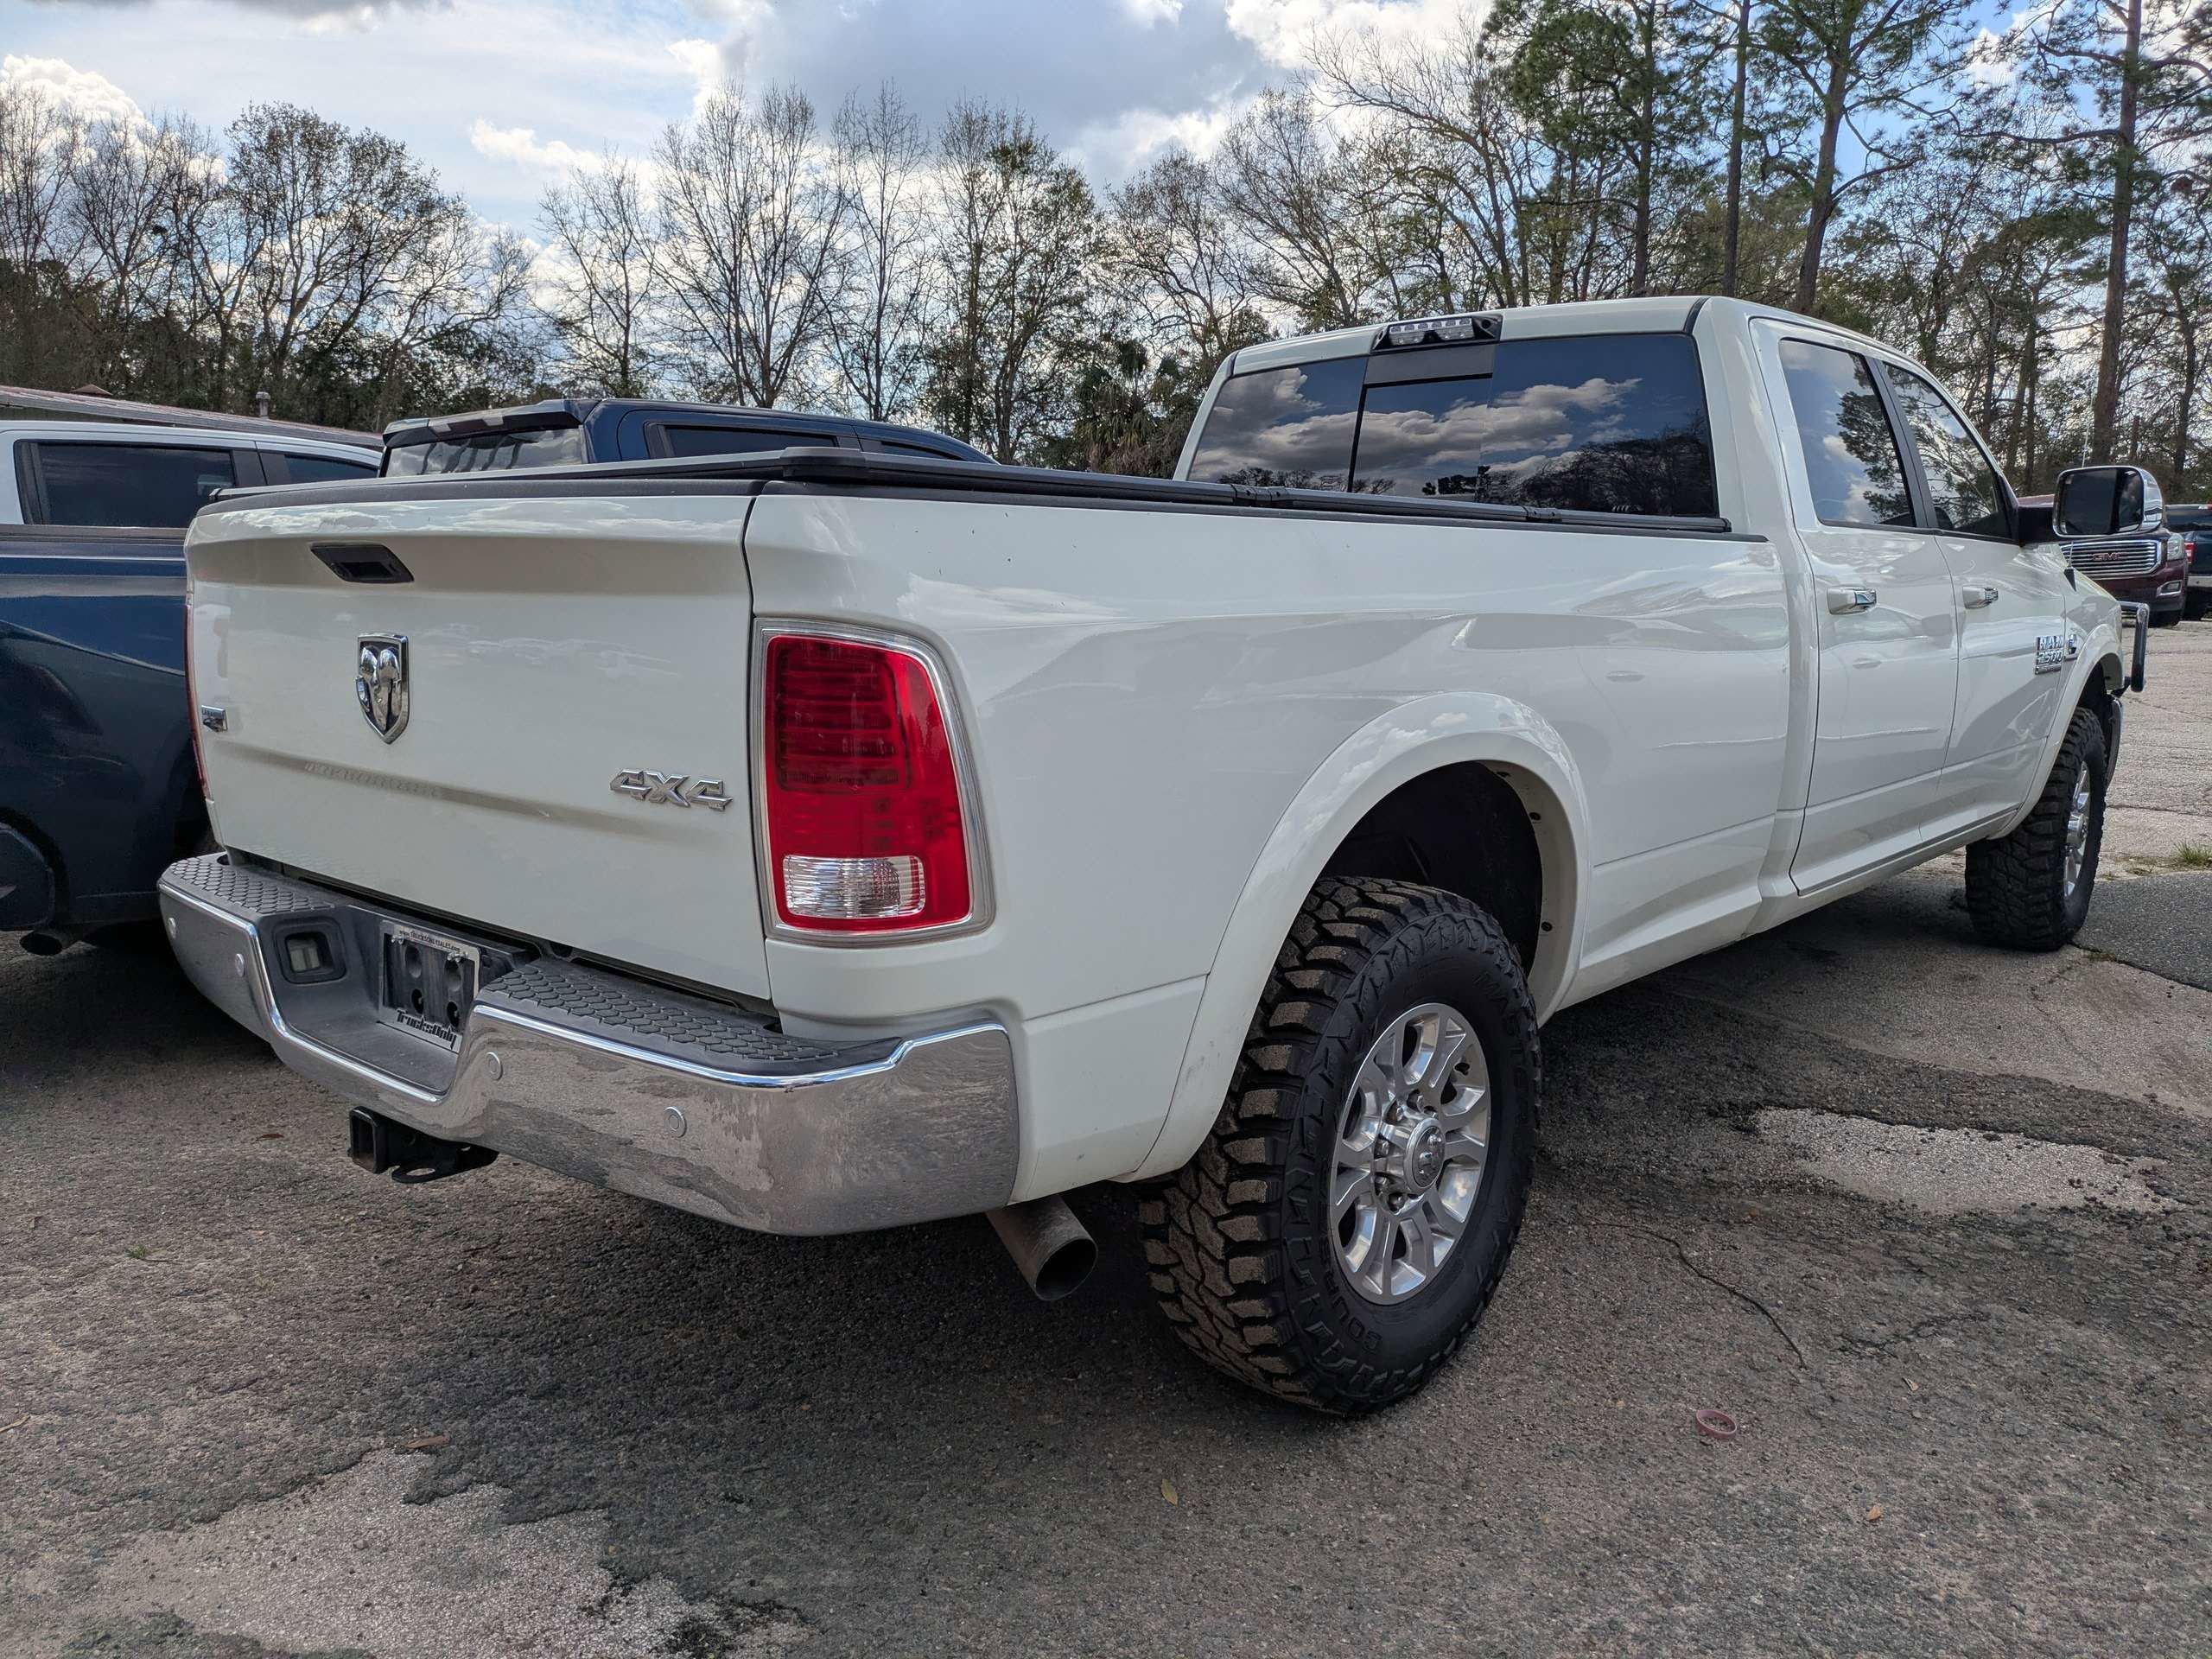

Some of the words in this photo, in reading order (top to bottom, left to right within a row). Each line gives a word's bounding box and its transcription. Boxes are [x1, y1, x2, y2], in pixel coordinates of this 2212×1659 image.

[2093, 552, 2122, 561] GMC
[2039, 635, 2063, 651] RAM
[2038, 650, 2063, 664] 2500
[396, 1009, 457, 1049] TrucksOnly
